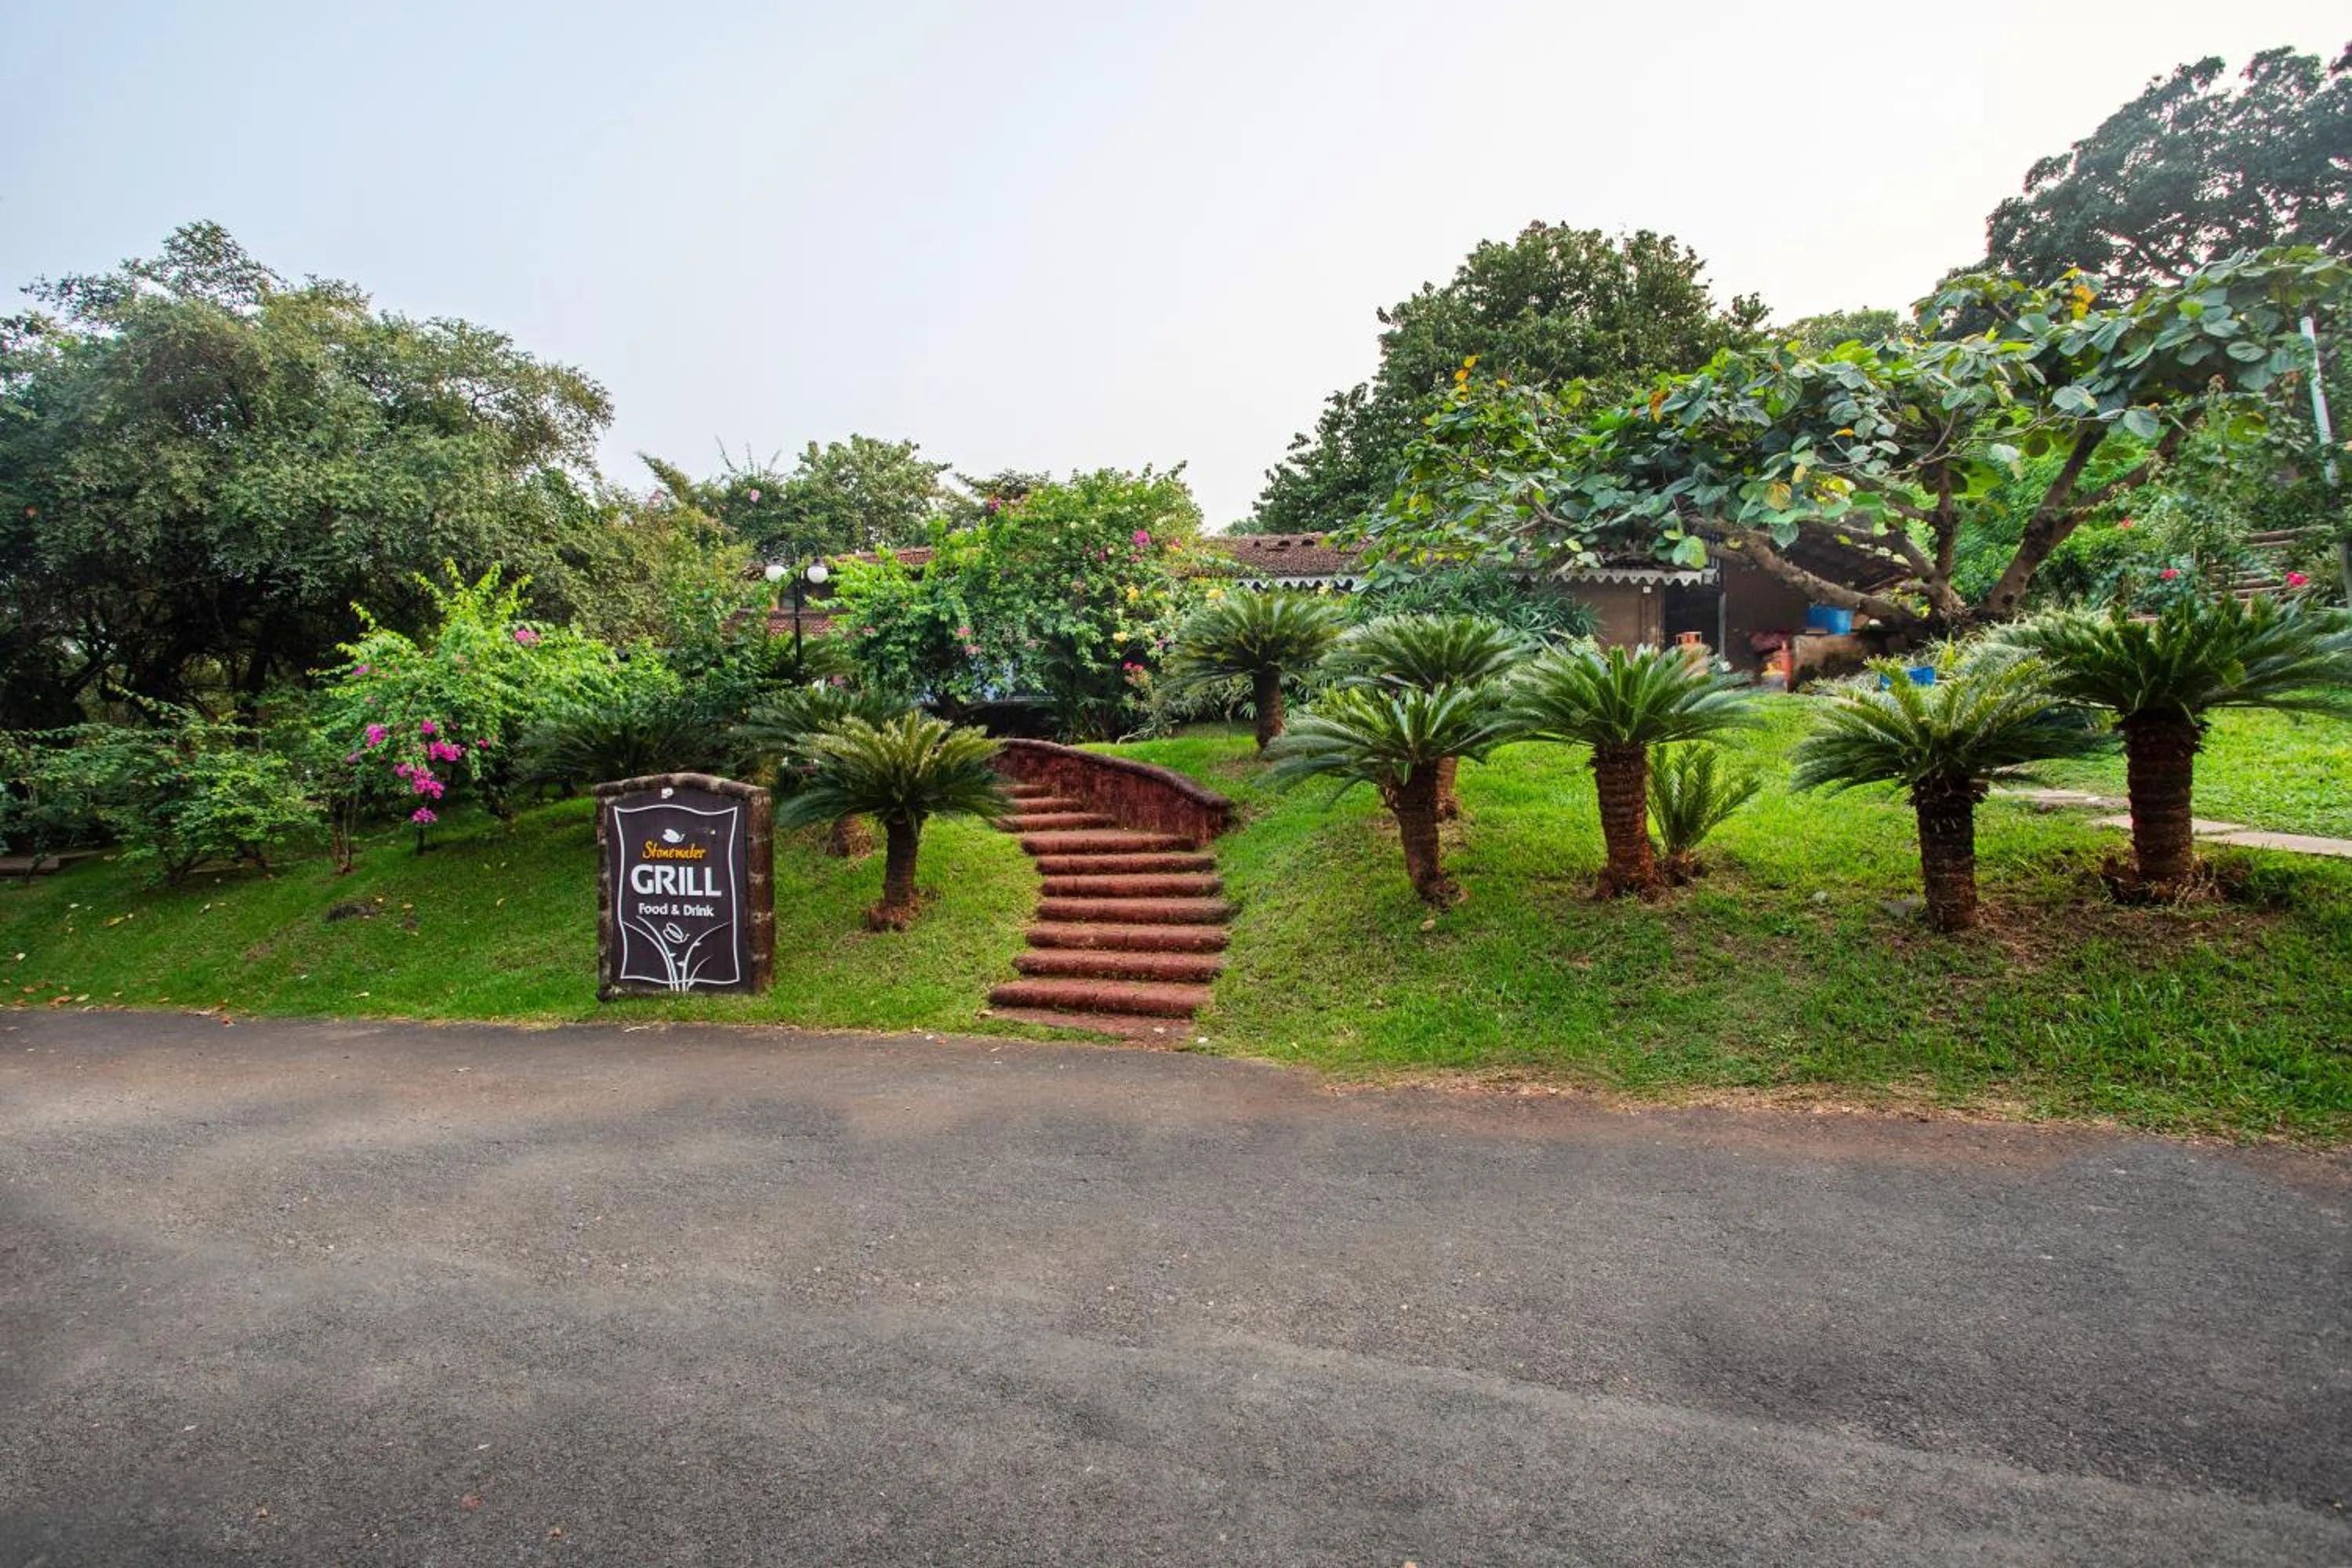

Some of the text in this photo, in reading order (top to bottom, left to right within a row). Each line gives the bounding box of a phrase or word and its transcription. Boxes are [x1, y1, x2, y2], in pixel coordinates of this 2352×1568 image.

[630, 864, 721, 896] GRILL
[638, 903, 714, 916] Food & Drink
